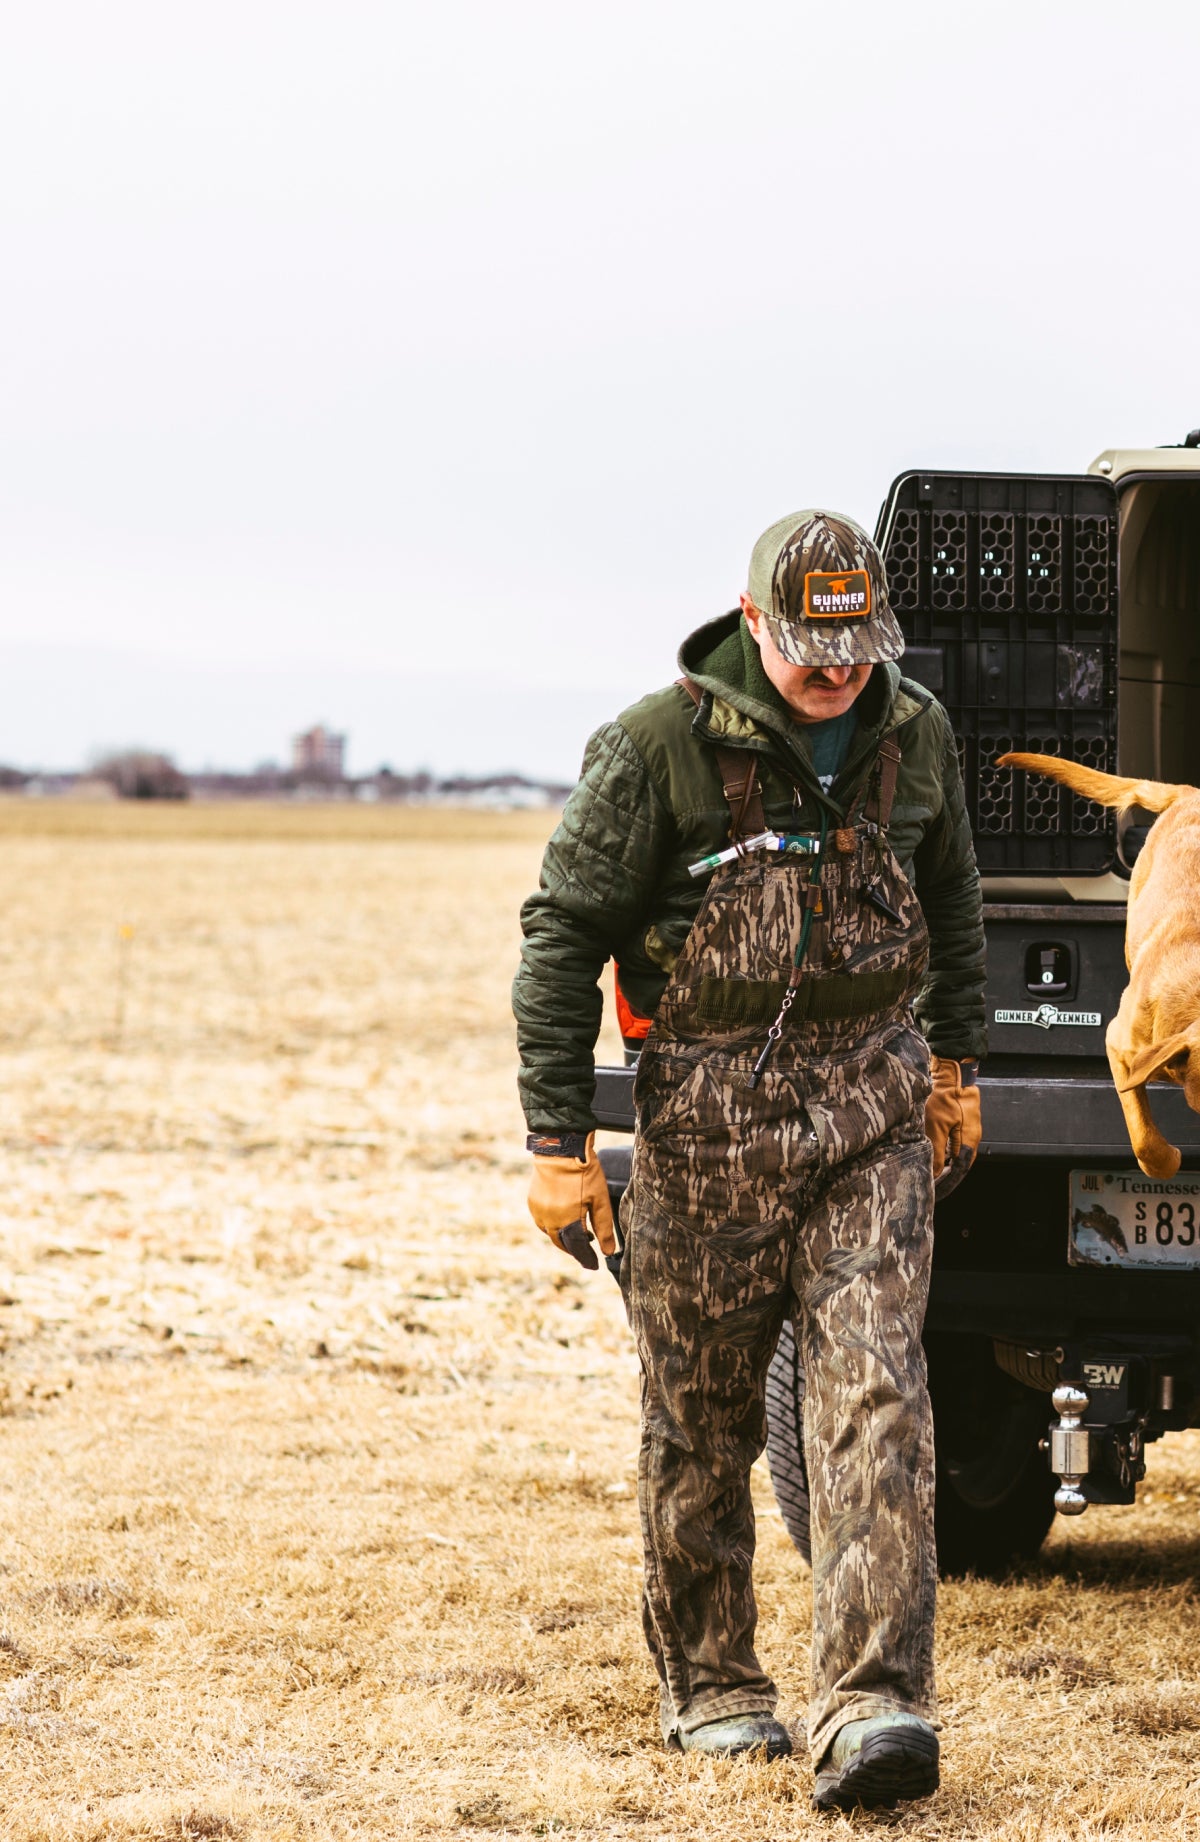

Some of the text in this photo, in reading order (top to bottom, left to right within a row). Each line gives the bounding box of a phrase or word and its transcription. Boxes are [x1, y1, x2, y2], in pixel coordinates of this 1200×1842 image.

[813, 592, 865, 606] GUNNER
[819, 604, 860, 612] KENNELS
[996, 1011, 1097, 1024] GUNNER KENNELS
[1082, 1175, 1099, 1191] JUL
